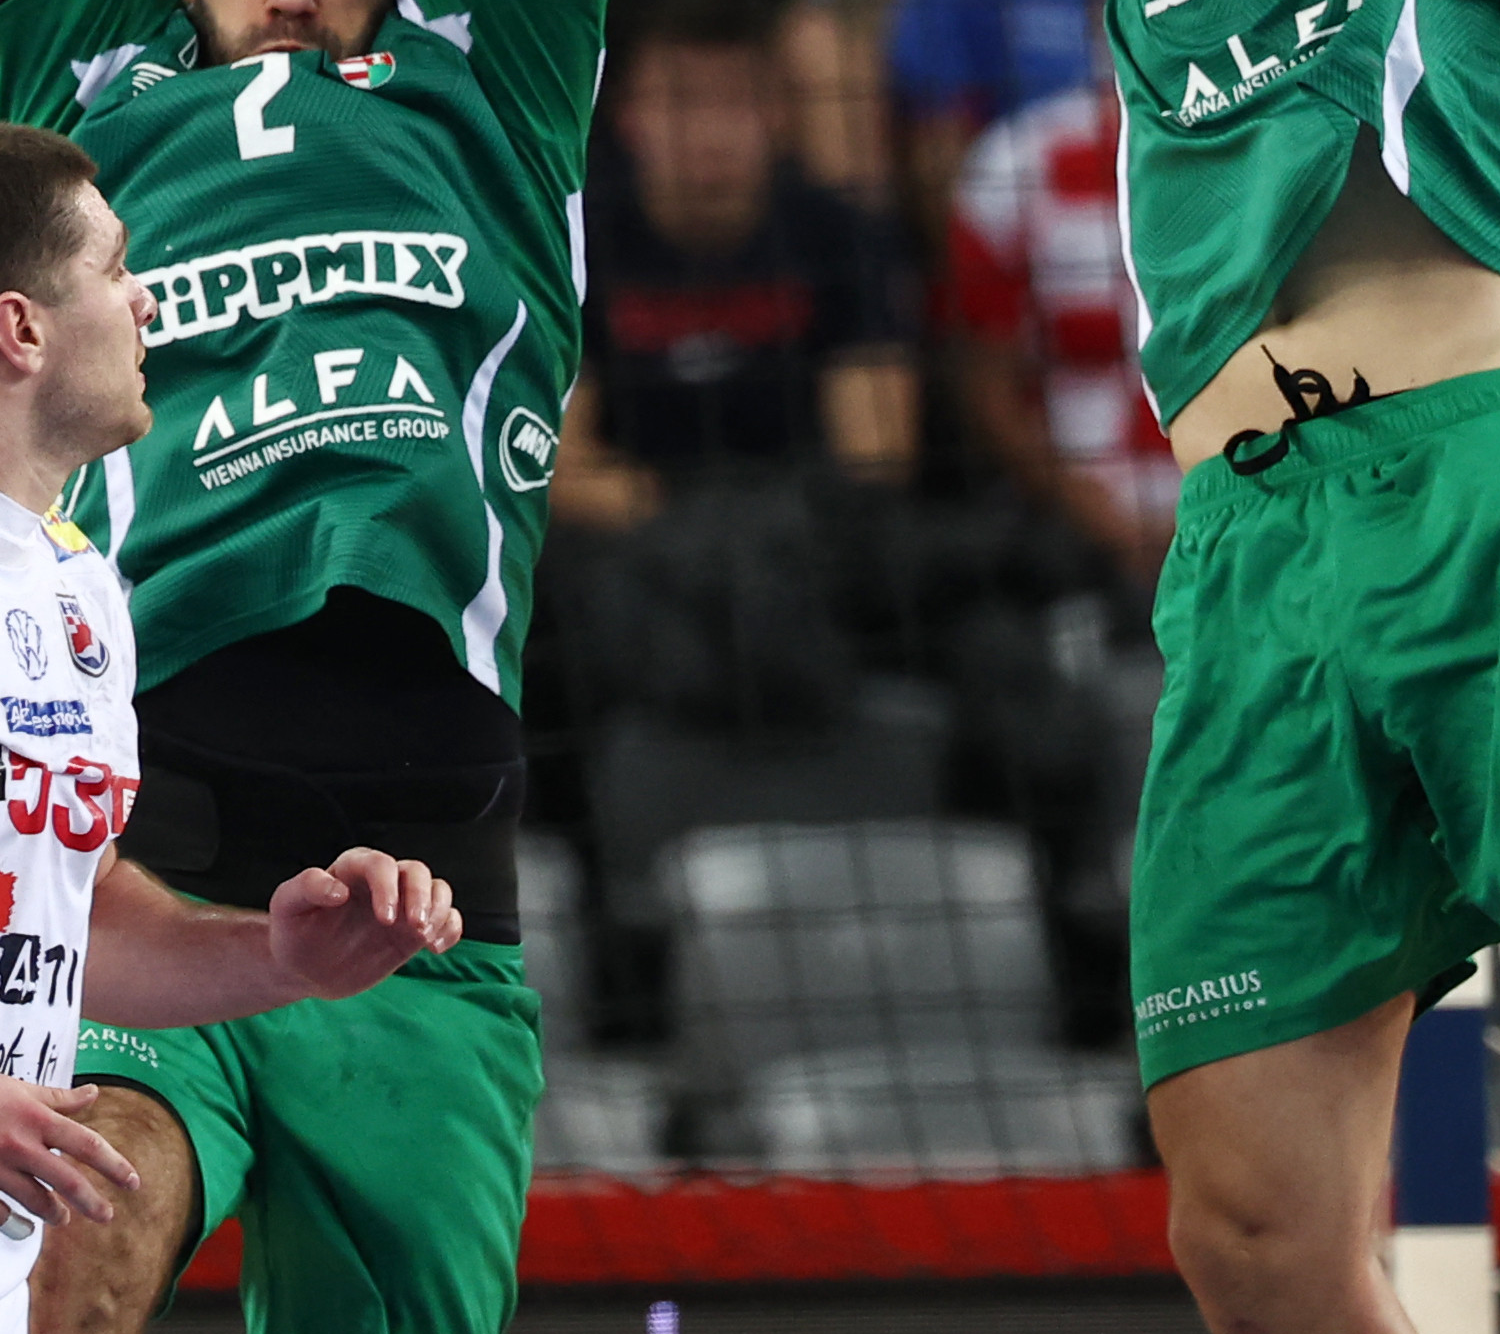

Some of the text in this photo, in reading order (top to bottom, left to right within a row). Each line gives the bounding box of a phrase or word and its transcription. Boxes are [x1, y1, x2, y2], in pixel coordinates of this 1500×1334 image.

[230, 51, 296, 161] 2
[193, 348, 436, 450] ALFA
[199, 417, 450, 491] VIENNA INSURANCE GROUP
[1136, 969, 1262, 1020] MERCARIUS
[79, 1027, 158, 1059] ARIUS
